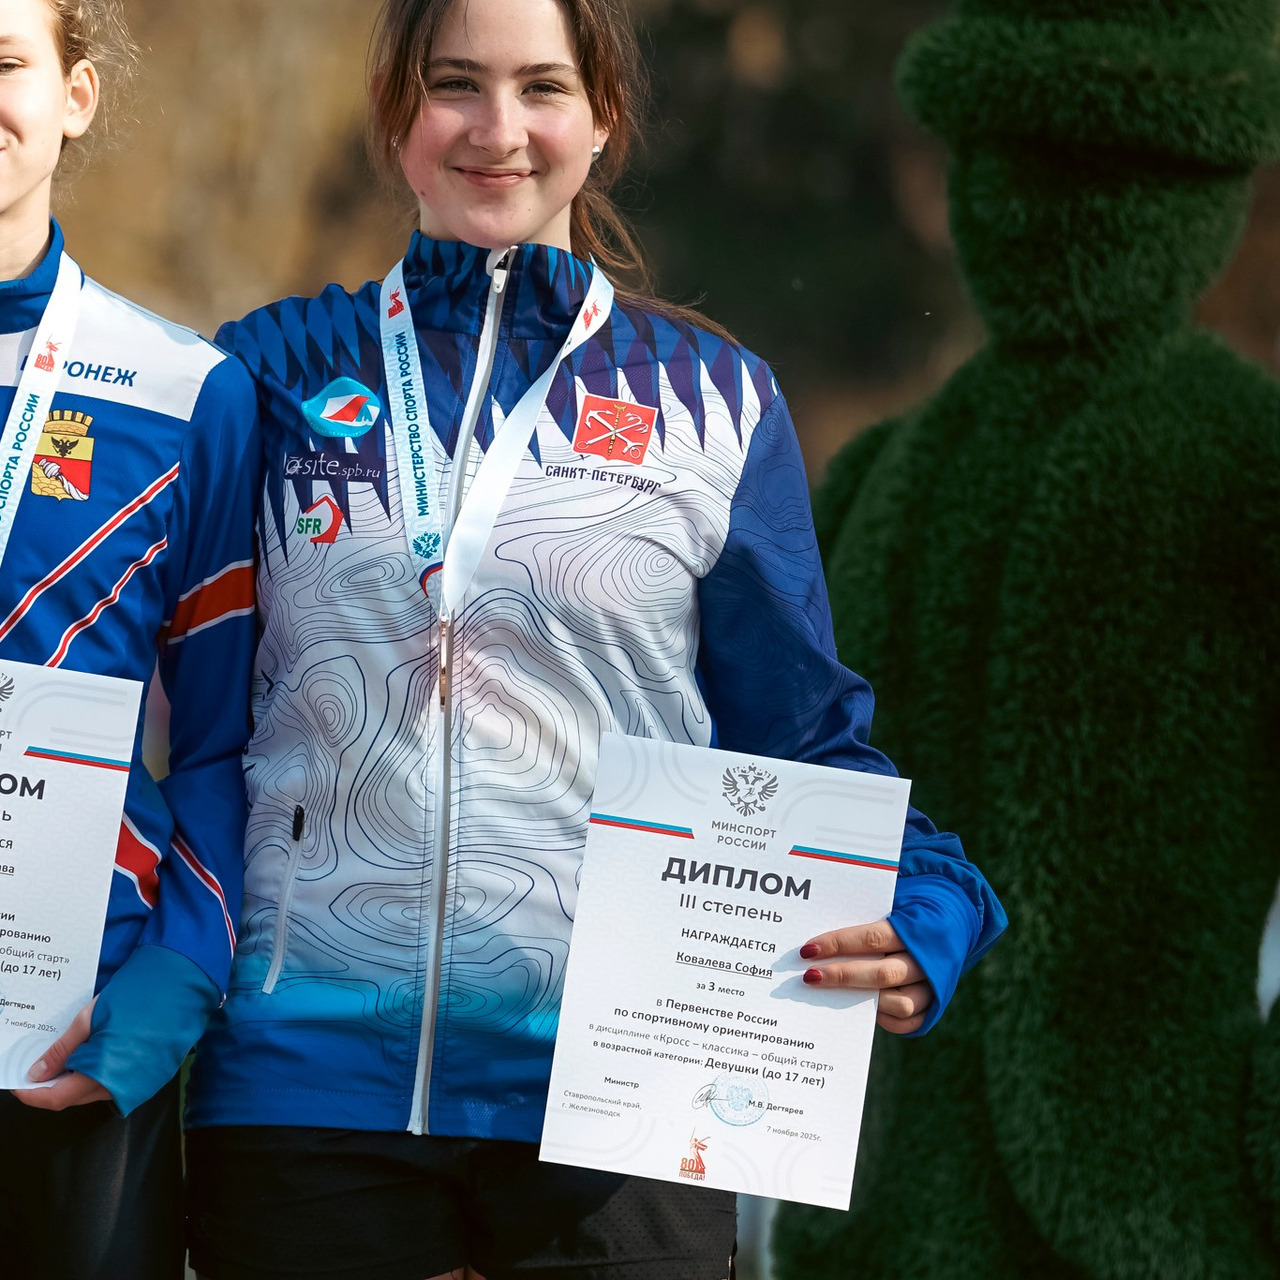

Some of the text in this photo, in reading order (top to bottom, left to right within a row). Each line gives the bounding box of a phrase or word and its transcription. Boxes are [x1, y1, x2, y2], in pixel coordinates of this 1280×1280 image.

[395, 332, 411, 376] РОССИИ
[401, 379, 417, 421] СПОРТА
[12, 394, 40, 451] РОССИИ
[408, 423, 429, 516] МИНИСТЕРСТВО
[545, 465, 661, 495] САНКТ-ПЕТЕРБУРГ
[297, 518, 322, 534] SFR
[711, 820, 777, 838] МИНСПОРТ
[717, 834, 766, 850] РОССИИ
[661, 856, 811, 900] ДИПЛОМ
[679, 893, 782, 923] III степень
[681, 927, 775, 953] НАГРАЖДАЕТСЯ
[0, 945, 34, 959] общий
[36, 953, 70, 964] старт»
[676, 951, 772, 976] Ковалева София
[0, 960, 19, 973] (до
[22, 964, 36, 974] 17
[37, 969, 61, 981] лет)
[708, 981, 715, 991] 3
[717, 986, 745, 996] место
[656, 998, 777, 1026] в Первенстве России
[10, 1020, 35, 1029] ноября
[36, 1023, 60, 1034] 2025г.
[614, 1008, 814, 1050] по спортивному ориентированию
[595, 1024, 650, 1040] дисциплине
[653, 1033, 690, 1047] «Кросс
[701, 1042, 749, 1057] классика
[760, 1052, 797, 1066] общий
[799, 1060, 834, 1072] старт»
[600, 1041, 651, 1056] возрастной
[653, 1051, 703, 1065] категории:
[704, 1057, 758, 1075] Девушки
[762, 1066, 781, 1080] (до
[785, 1071, 799, 1082] 17
[801, 1076, 825, 1088] лет)
[603, 1076, 639, 1089] Министр
[563, 1089, 641, 1110] Ставропольский край,
[568, 1102, 620, 1117] Железноводск
[765, 1102, 803, 1115] Дегтярев
[772, 1128, 798, 1137] ноября
[799, 1131, 821, 1141] 2025г.
[680, 1157, 695, 1171] 80
